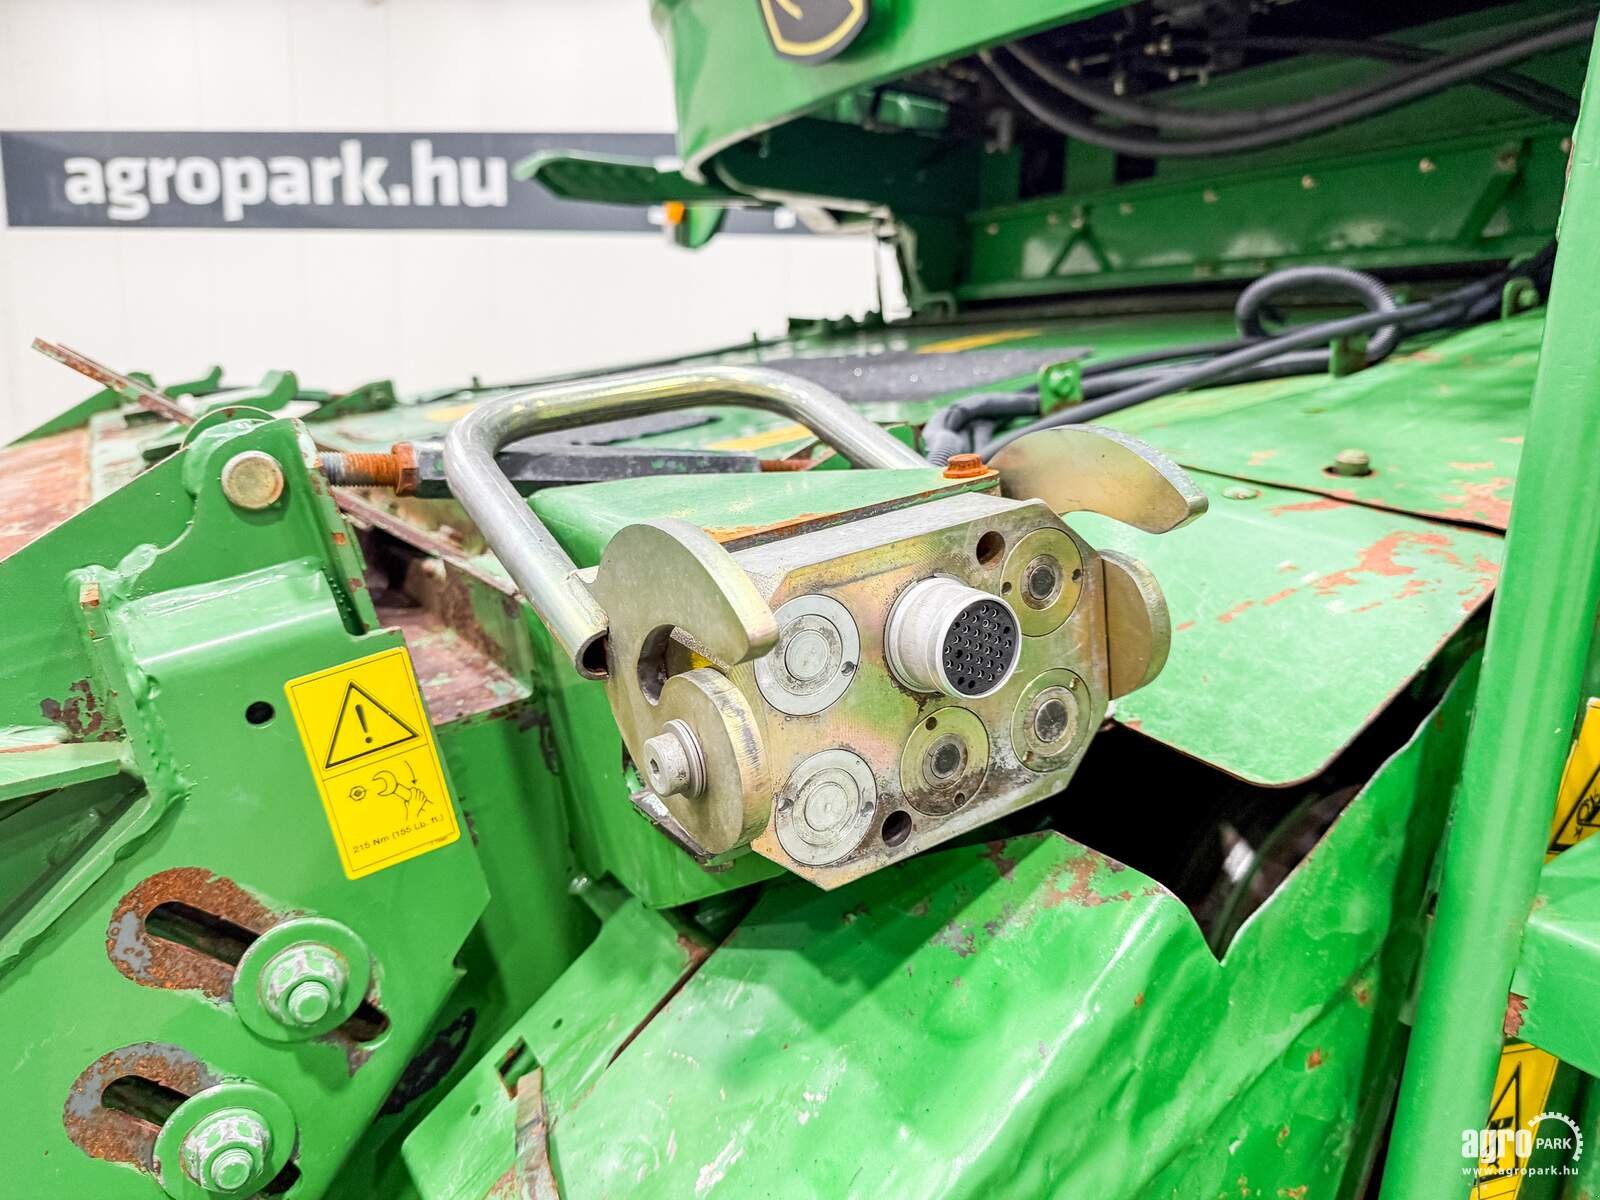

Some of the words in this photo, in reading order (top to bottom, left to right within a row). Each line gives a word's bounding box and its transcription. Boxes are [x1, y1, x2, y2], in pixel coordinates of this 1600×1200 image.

[64, 138, 508, 222] agropark.hu
[352, 842, 371, 854] 215
[373, 836, 390, 846] Nm
[392, 827, 412, 840] (155
